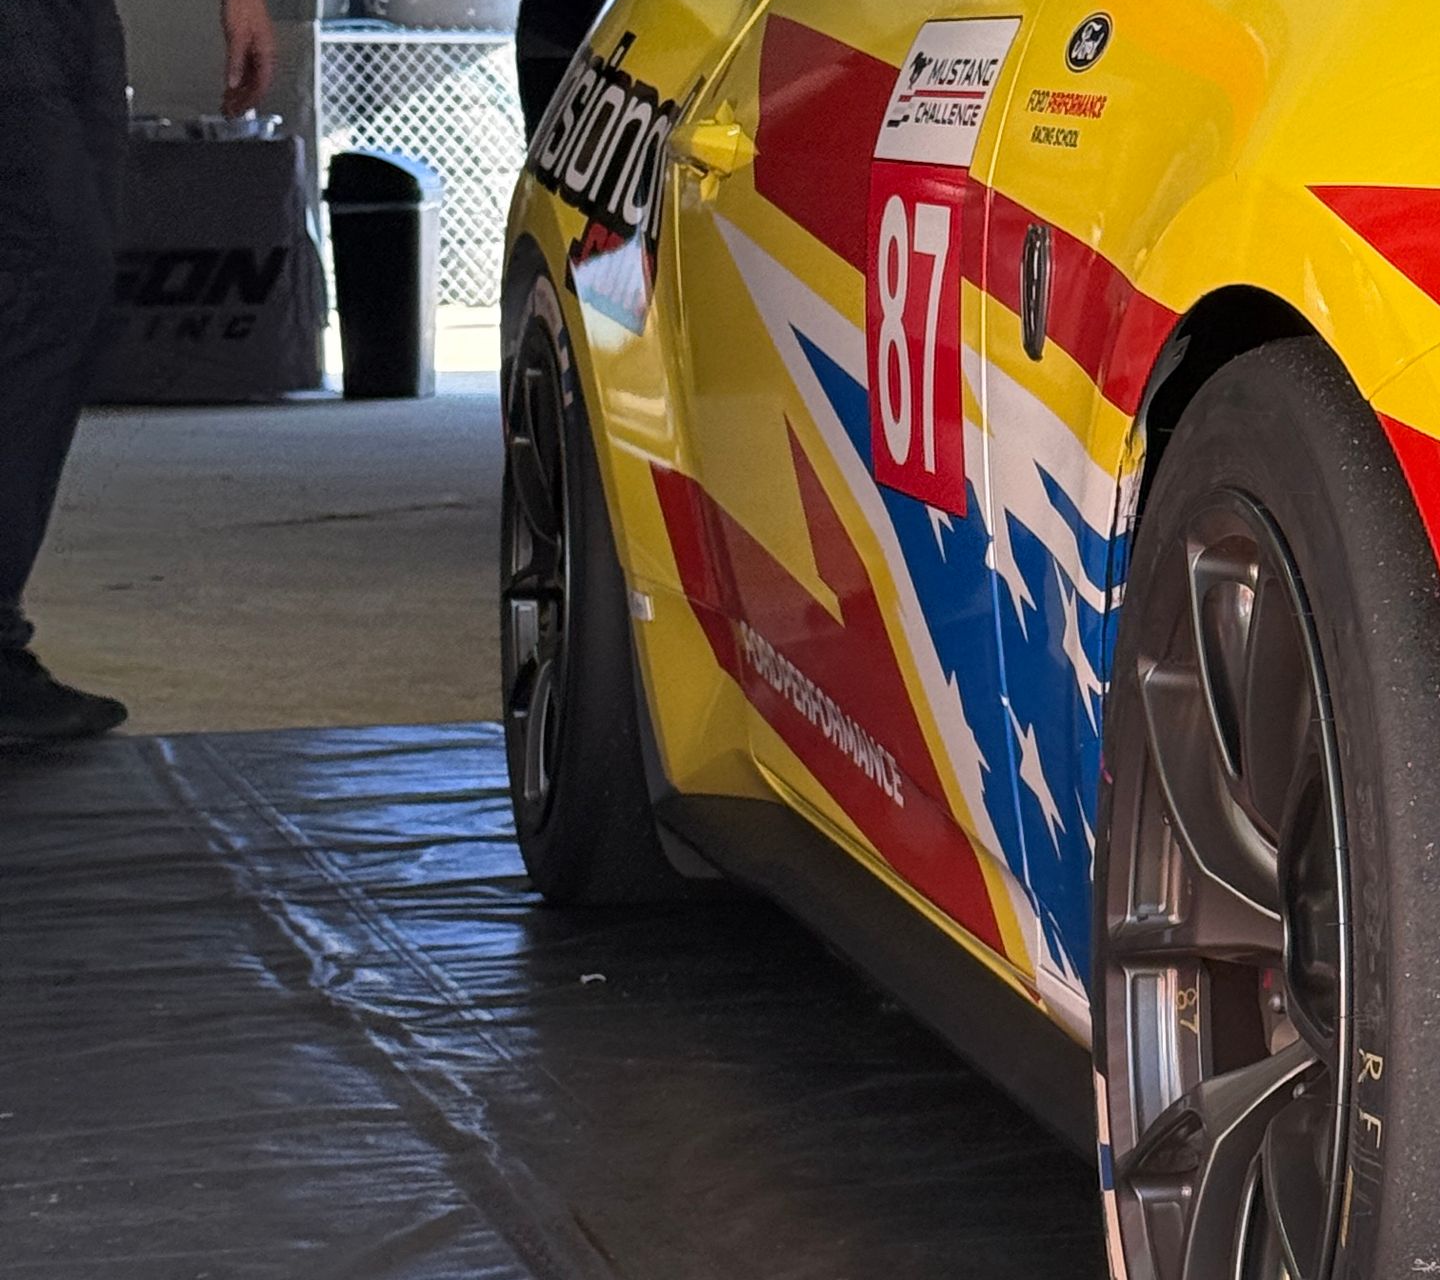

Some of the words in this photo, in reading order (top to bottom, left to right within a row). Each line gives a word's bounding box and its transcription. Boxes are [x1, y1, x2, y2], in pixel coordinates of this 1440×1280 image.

[914, 101, 982, 127] CHALLENGE
[928, 58, 999, 86] MUSTANG
[531, 44, 697, 241] sional
[877, 194, 953, 475] 87
